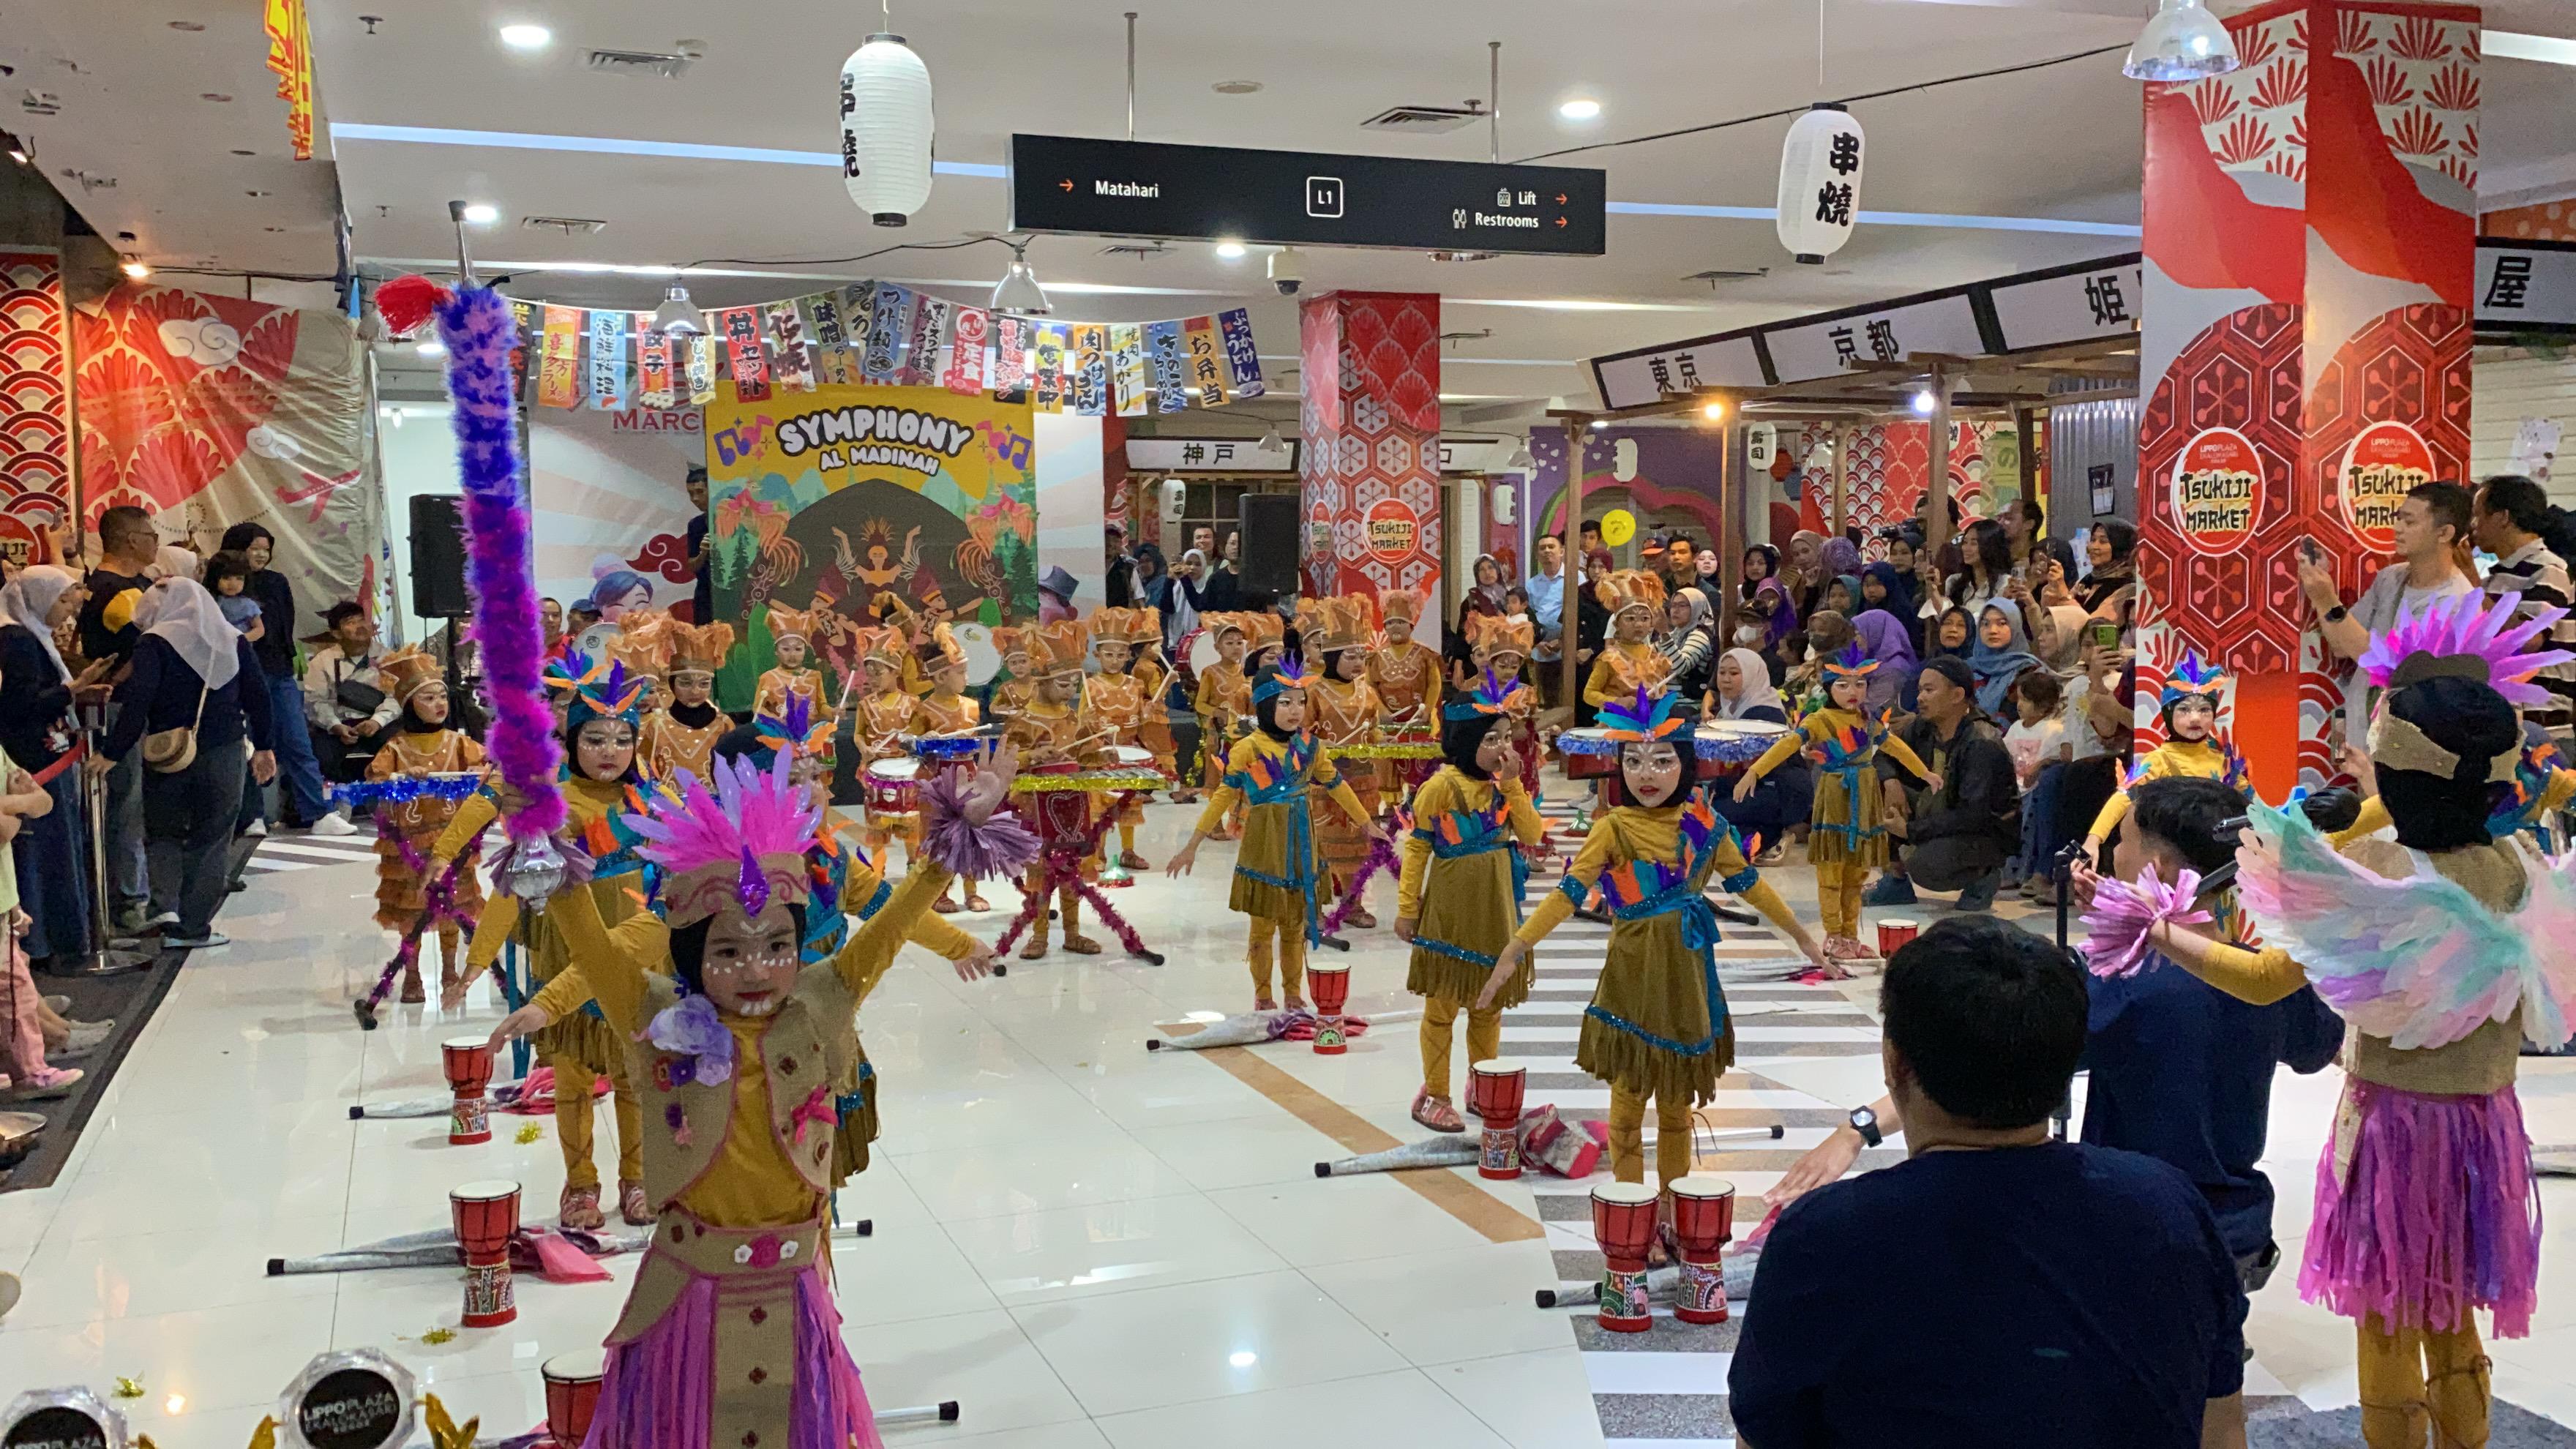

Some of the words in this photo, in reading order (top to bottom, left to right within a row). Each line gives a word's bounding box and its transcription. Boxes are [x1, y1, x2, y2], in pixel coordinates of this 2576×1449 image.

[1095, 180, 1158, 198] Matahari
[1318, 190, 1333, 205] L1
[1518, 191, 1537, 206] Lift
[1475, 212, 1540, 228] Restrooms
[1828, 319, 1900, 367] 京都
[1191, 334, 1224, 405] お弁当
[1648, 352, 1704, 393] 東京
[779, 408, 972, 455] SYMPHONY
[820, 449, 845, 471] AL
[850, 446, 940, 474] MADINAH
[1182, 442, 1235, 465] 神戸
[2179, 473, 2252, 503] TSUKIJI
[1367, 520, 1412, 536] TSUKIJI
[2185, 503, 2250, 533] MARKET
[2355, 500, 2400, 529] MARK
[1371, 535, 1412, 550] MARKET
